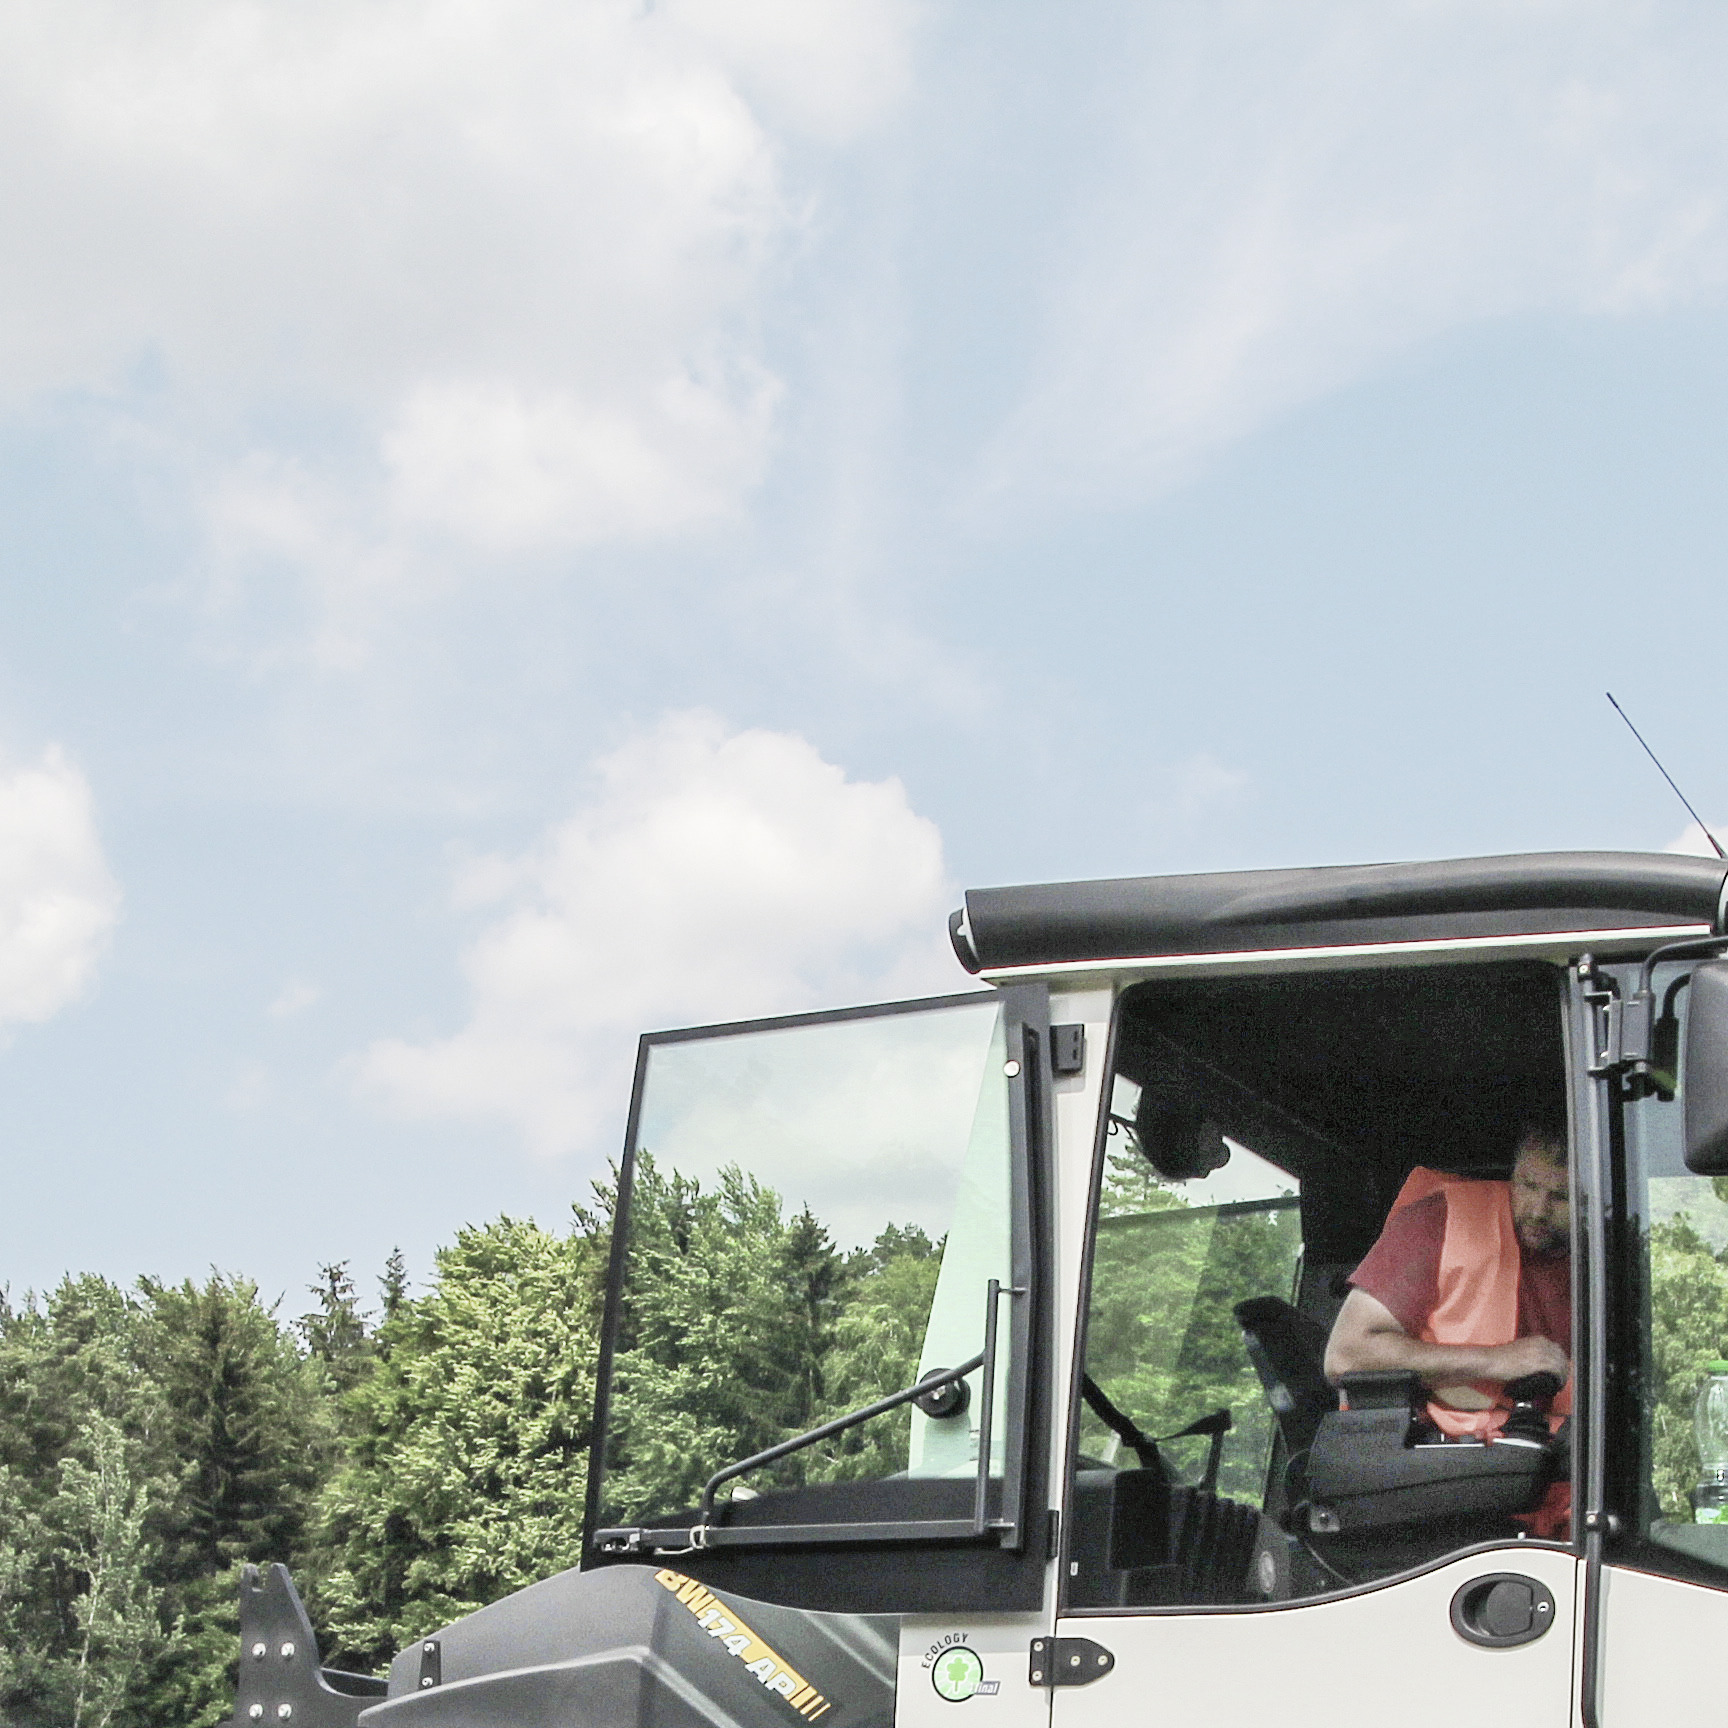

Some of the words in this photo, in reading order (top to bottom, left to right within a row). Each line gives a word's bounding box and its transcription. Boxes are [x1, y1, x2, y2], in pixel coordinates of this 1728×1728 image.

[654, 1568, 716, 1614] BW
[697, 1608, 753, 1657] 174
[744, 1657, 798, 1698] AP
[921, 1632, 969, 1669] ECOLOGY
